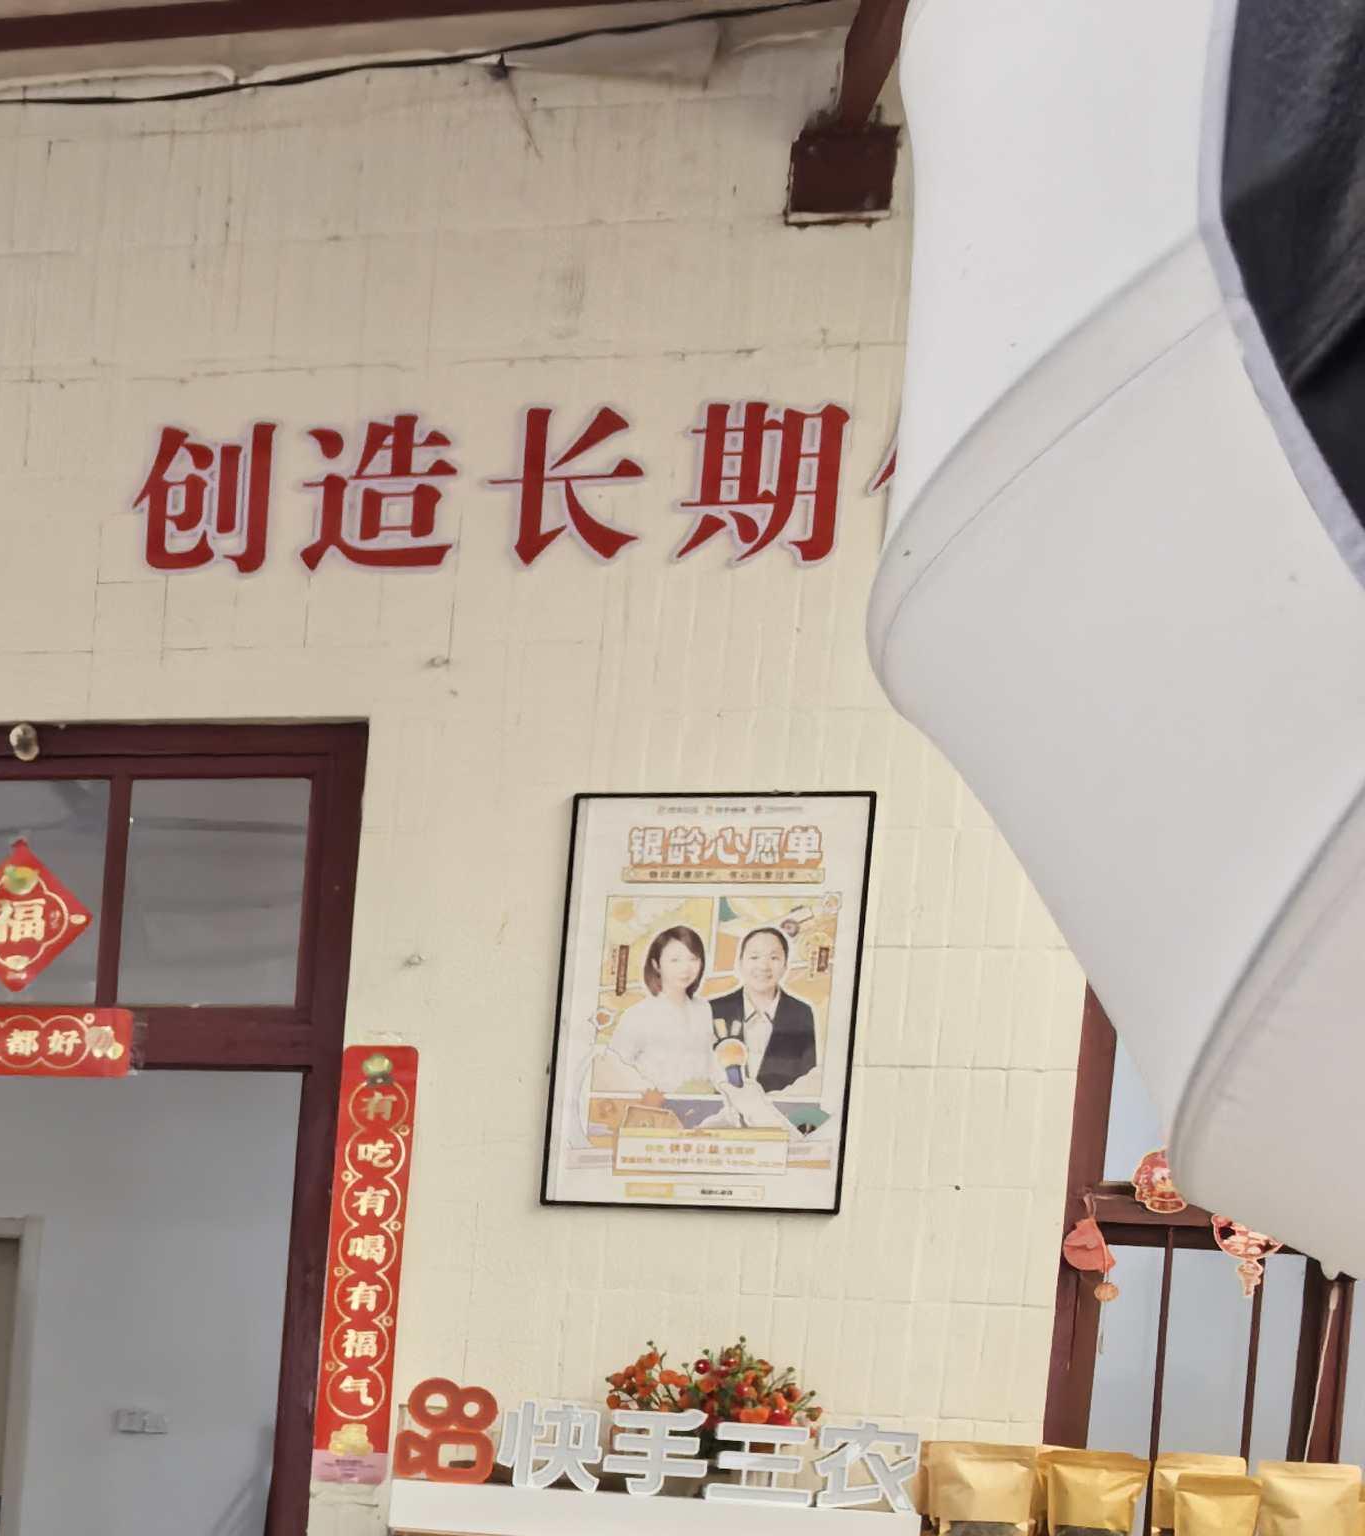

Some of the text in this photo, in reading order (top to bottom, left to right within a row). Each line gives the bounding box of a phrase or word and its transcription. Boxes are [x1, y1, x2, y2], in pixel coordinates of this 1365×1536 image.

[132, 401, 897, 574] 创造长期
[629, 826, 823, 866] 银龄心愿单
[339, 1091, 398, 1407] 有吃有喝有福气
[496, 1400, 920, 1514] 快手三农
